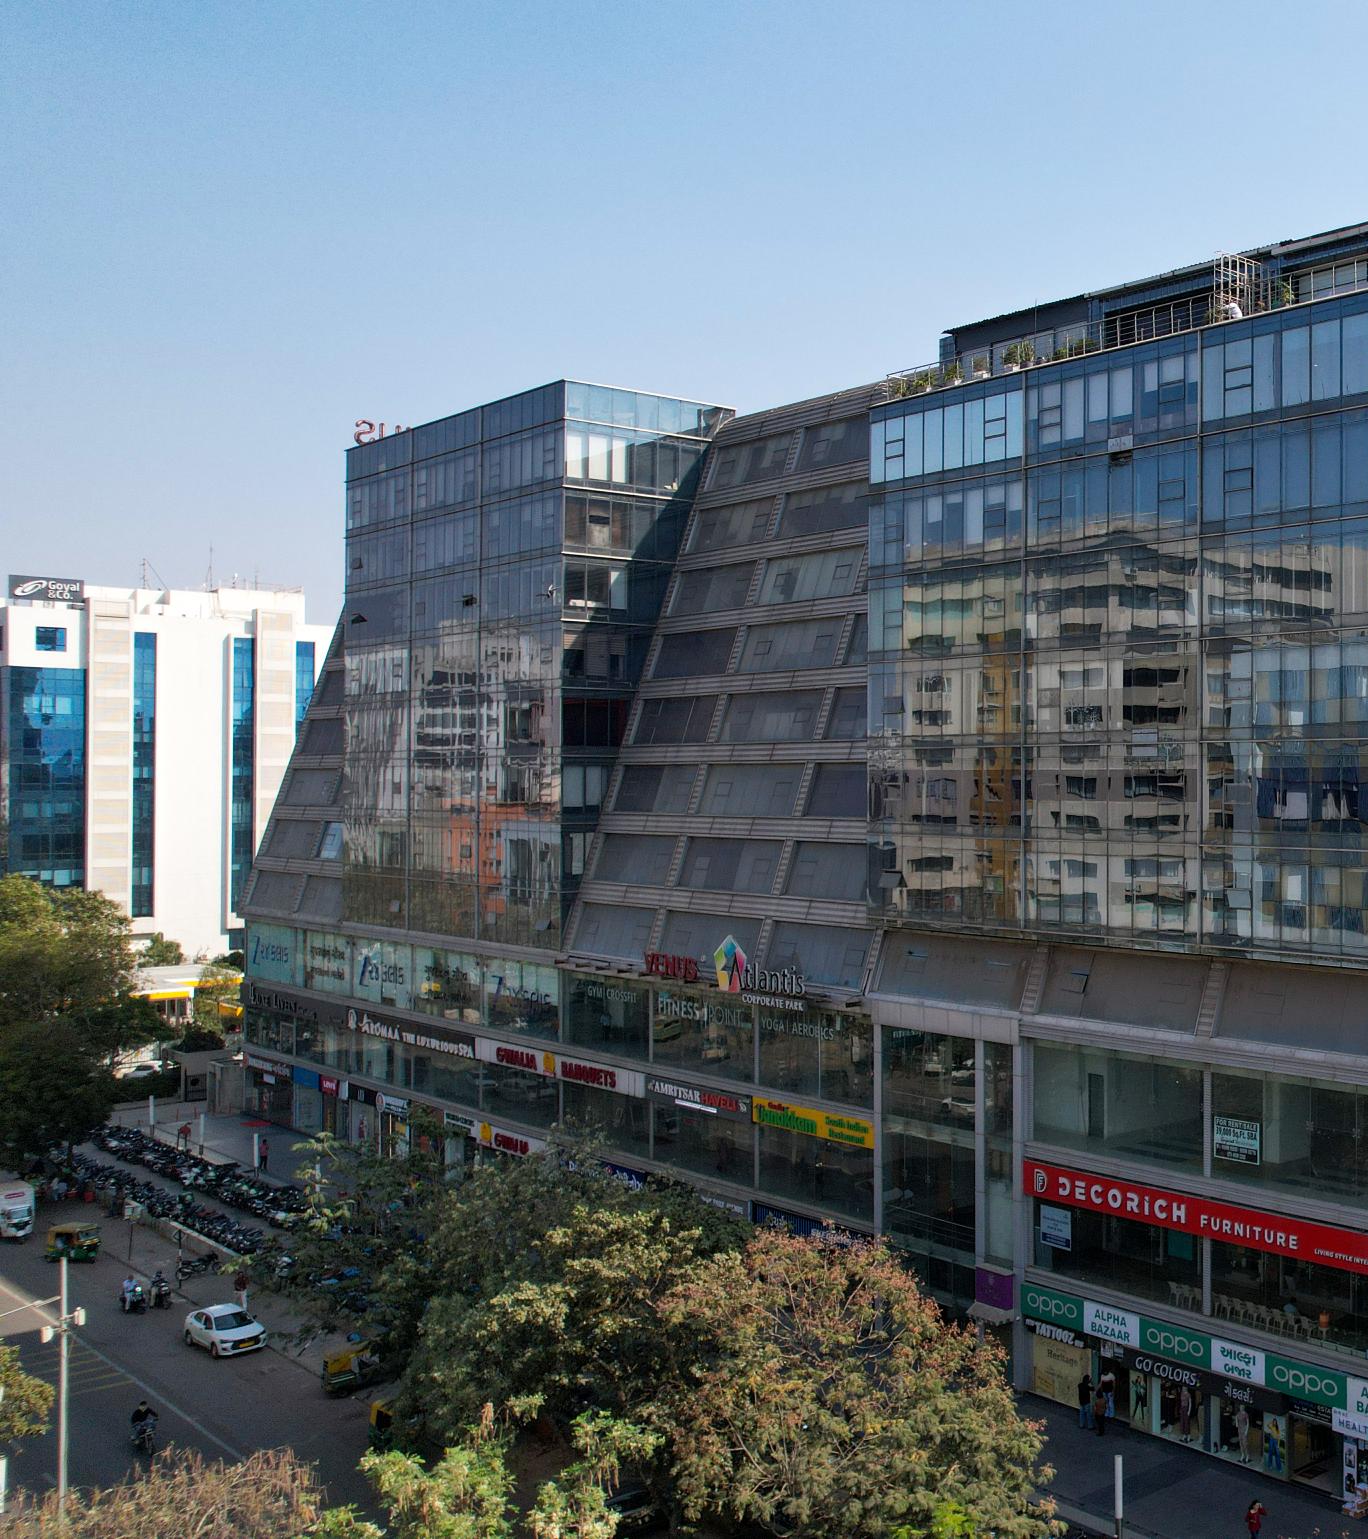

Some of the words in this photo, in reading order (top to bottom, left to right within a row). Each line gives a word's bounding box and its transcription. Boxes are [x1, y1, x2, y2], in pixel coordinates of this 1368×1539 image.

[48, 581, 80, 593] Goyal
[644, 952, 698, 980] VENUS
[728, 952, 806, 996] Atlantis
[587, 985, 603, 998] GYM
[606, 988, 637, 1003] CROSSFIT
[742, 994, 783, 1010] CORPORATE
[785, 999, 804, 1011] PARK
[658, 996, 700, 1020] FITNESS
[761, 1017, 785, 1032] YOGA
[792, 1022, 834, 1040] AEROBICS
[561, 1061, 617, 1089] BANQUETS
[654, 1081, 700, 1102] AMRITSAR
[700, 1091, 737, 1112] HAVELI
[1216, 1118, 1227, 1126] FOR
[1200, 1214, 1299, 1250] FURNITURE
[1314, 1247, 1334, 1257] LIVING
[1335, 1252, 1353, 1262] STYLE
[1094, 1309, 1127, 1327] ALPHA
[1090, 1321, 1130, 1343] BAZAAR
[1135, 1357, 1152, 1372] GO
[1153, 1362, 1197, 1386] COLORS
